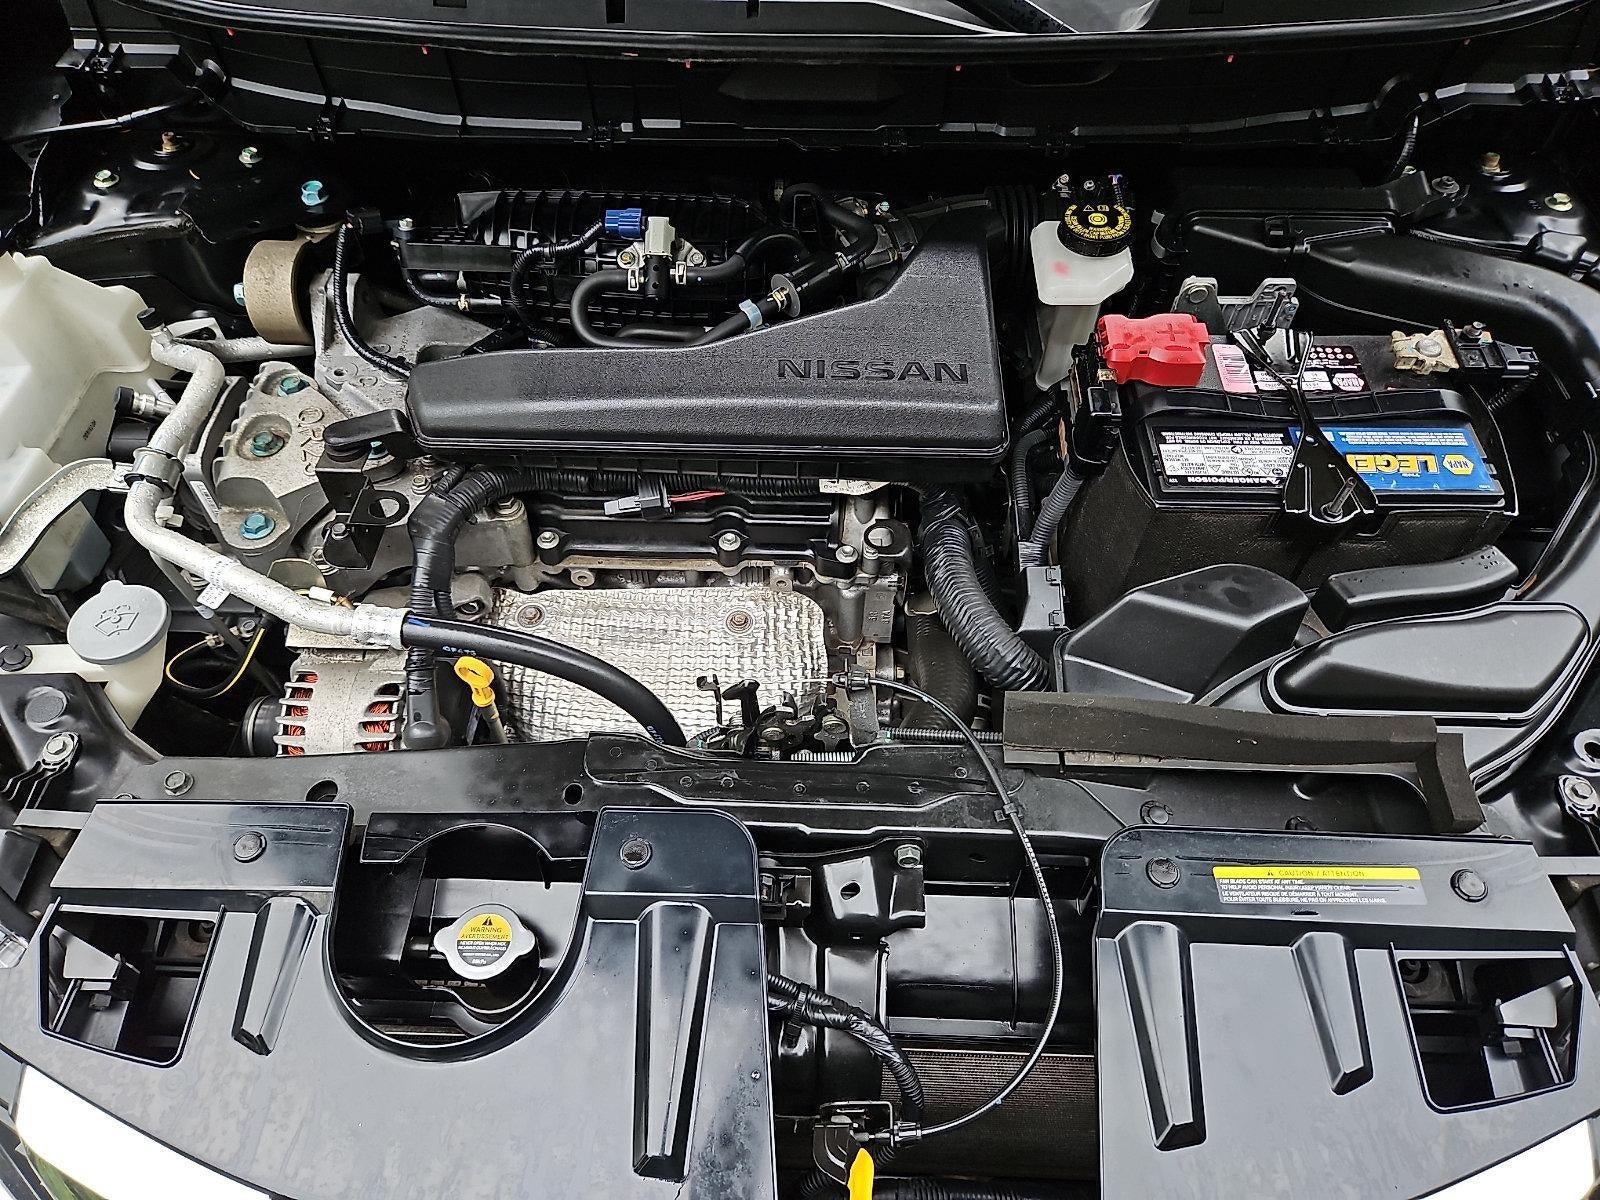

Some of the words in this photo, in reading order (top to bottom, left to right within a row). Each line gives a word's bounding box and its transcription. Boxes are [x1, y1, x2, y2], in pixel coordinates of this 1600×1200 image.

[777, 359, 969, 384] NISSAN
[1447, 459, 1470, 468] NAPA
[1322, 870, 1366, 878] ATTENTION
